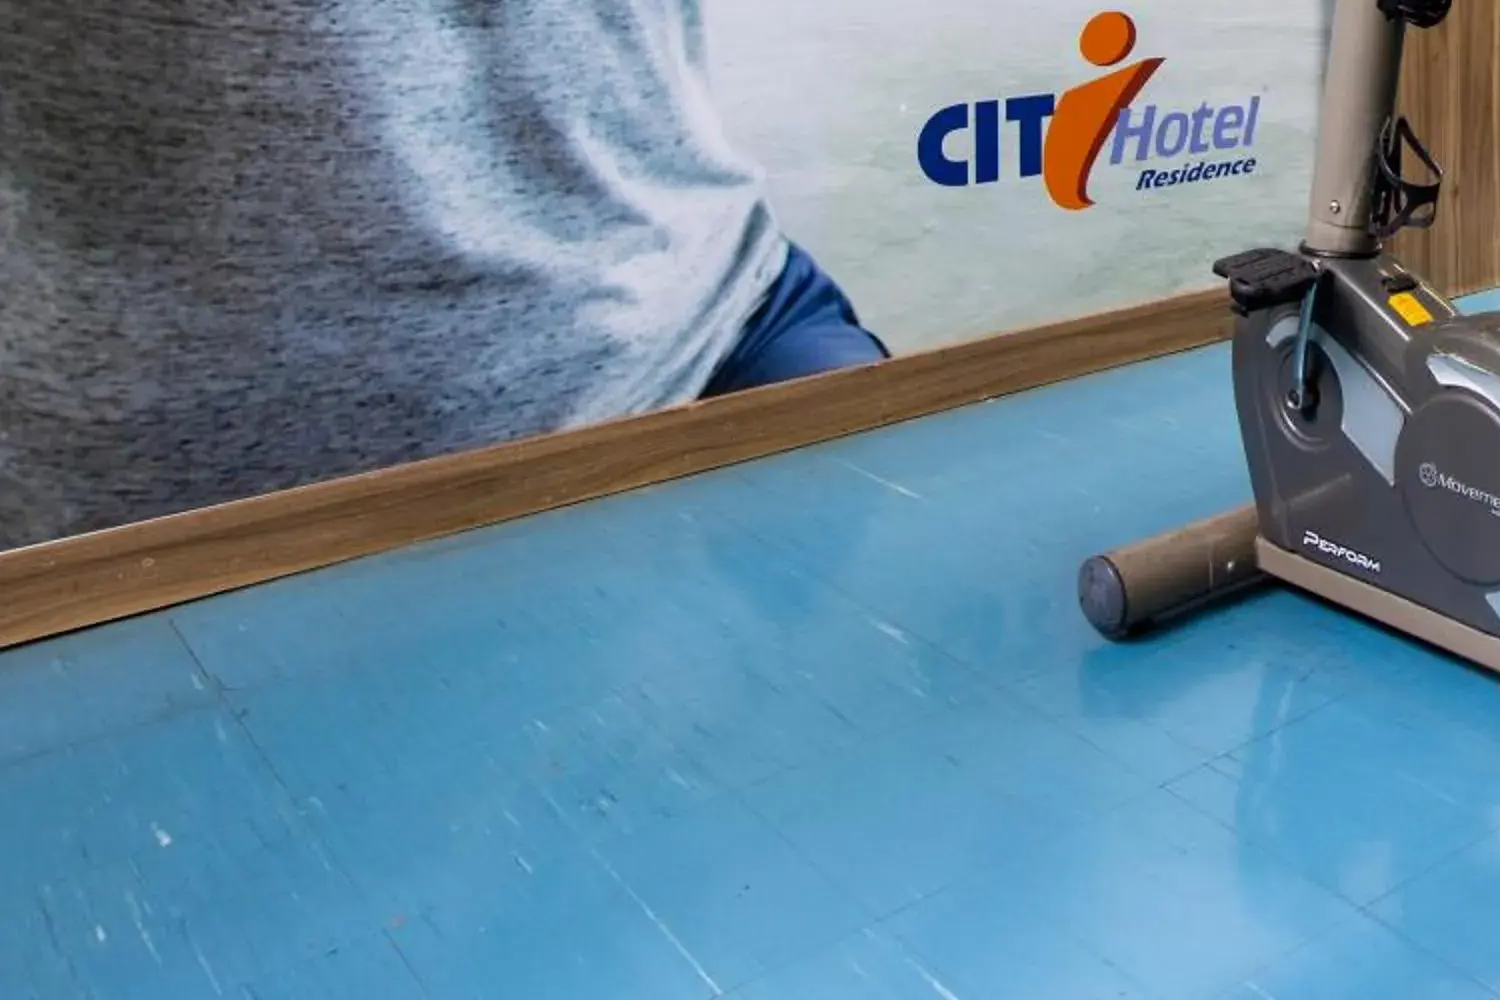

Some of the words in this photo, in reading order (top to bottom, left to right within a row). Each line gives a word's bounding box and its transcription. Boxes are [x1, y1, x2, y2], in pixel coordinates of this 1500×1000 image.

[1109, 96, 1261, 166] Hotel
[1135, 157, 1257, 191] Residence
[1303, 530, 1381, 572] PERFORM
